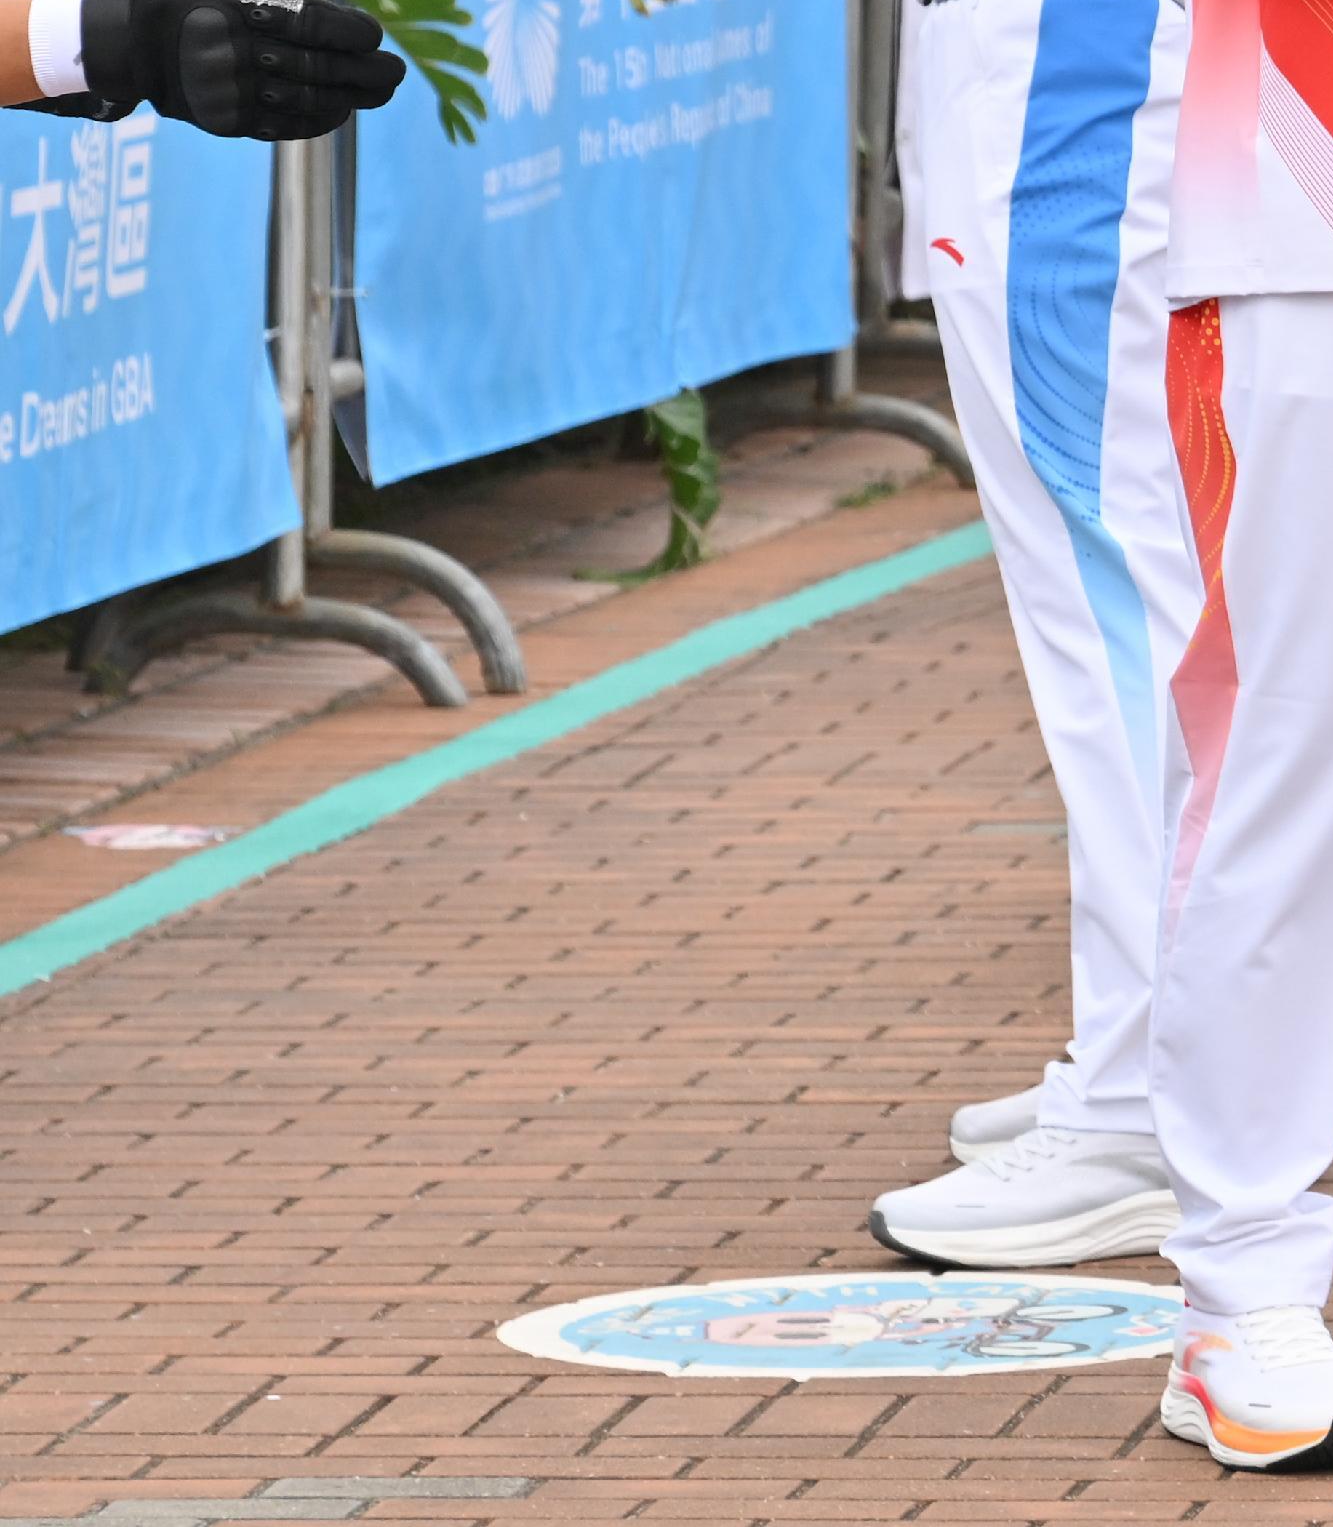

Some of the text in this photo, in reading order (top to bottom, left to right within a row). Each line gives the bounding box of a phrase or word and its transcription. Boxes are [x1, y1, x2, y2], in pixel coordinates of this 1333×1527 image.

[578, 53, 609, 98] The
[0, 113, 158, 336] 大灣區
[110, 351, 156, 426] GBA
